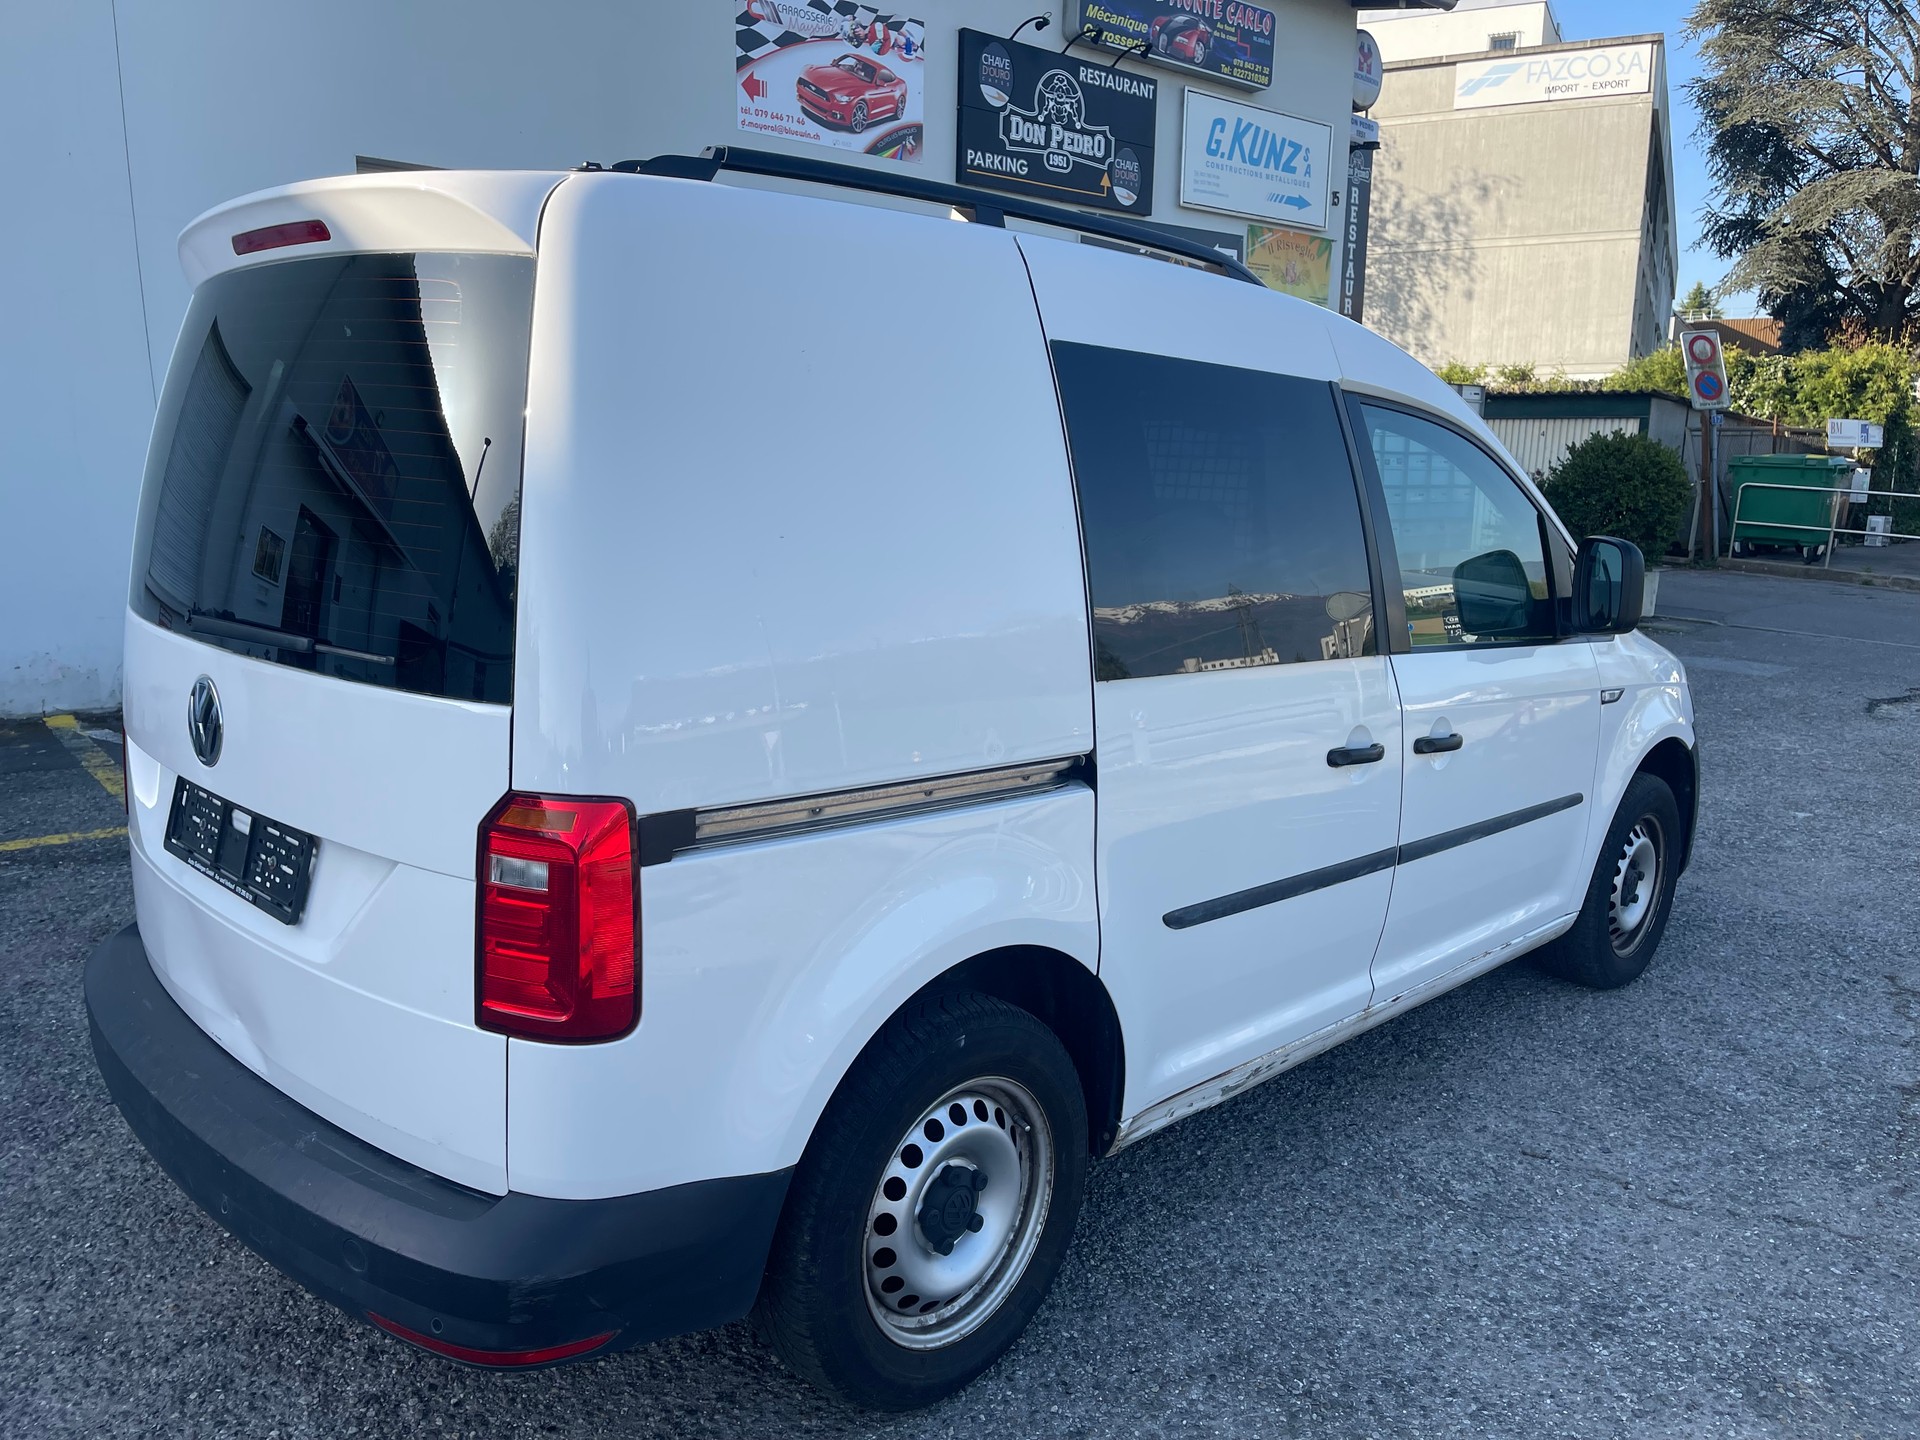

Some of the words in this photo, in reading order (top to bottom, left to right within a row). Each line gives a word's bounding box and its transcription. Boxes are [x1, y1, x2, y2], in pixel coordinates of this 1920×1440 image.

[777, 3, 833, 26] CARROSSERIE
[1086, 3, 1149, 34] Mécanique
[1226, 1, 1272, 36] CARLO
[788, 17, 838, 36] Mayoral
[1084, 23, 1147, 51] Crosserie
[982, 53, 1011, 70] CHAVE
[1526, 54, 1611, 84] FAZCO
[982, 65, 1011, 81] D'OURO
[1079, 66, 1155, 99] RESTAURANT
[1544, 83, 1579, 95] IMPORT
[1592, 79, 1631, 91] EXPORT
[754, 108, 769, 118] 079
[770, 111, 784, 122] 646
[785, 114, 794, 124] 71
[796, 117, 806, 126] 46
[1206, 116, 1303, 174] G.KUNZ
[966, 149, 1029, 176] PARKING
[1049, 153, 1067, 168] 1951
[1114, 158, 1139, 173] CHAVE
[1205, 160, 1263, 179] CONSTRUCTIONS
[1114, 168, 1139, 182] D'OURO
[1331, 190, 1340, 206] 15
[1343, 186, 1359, 317] RESTAUR
